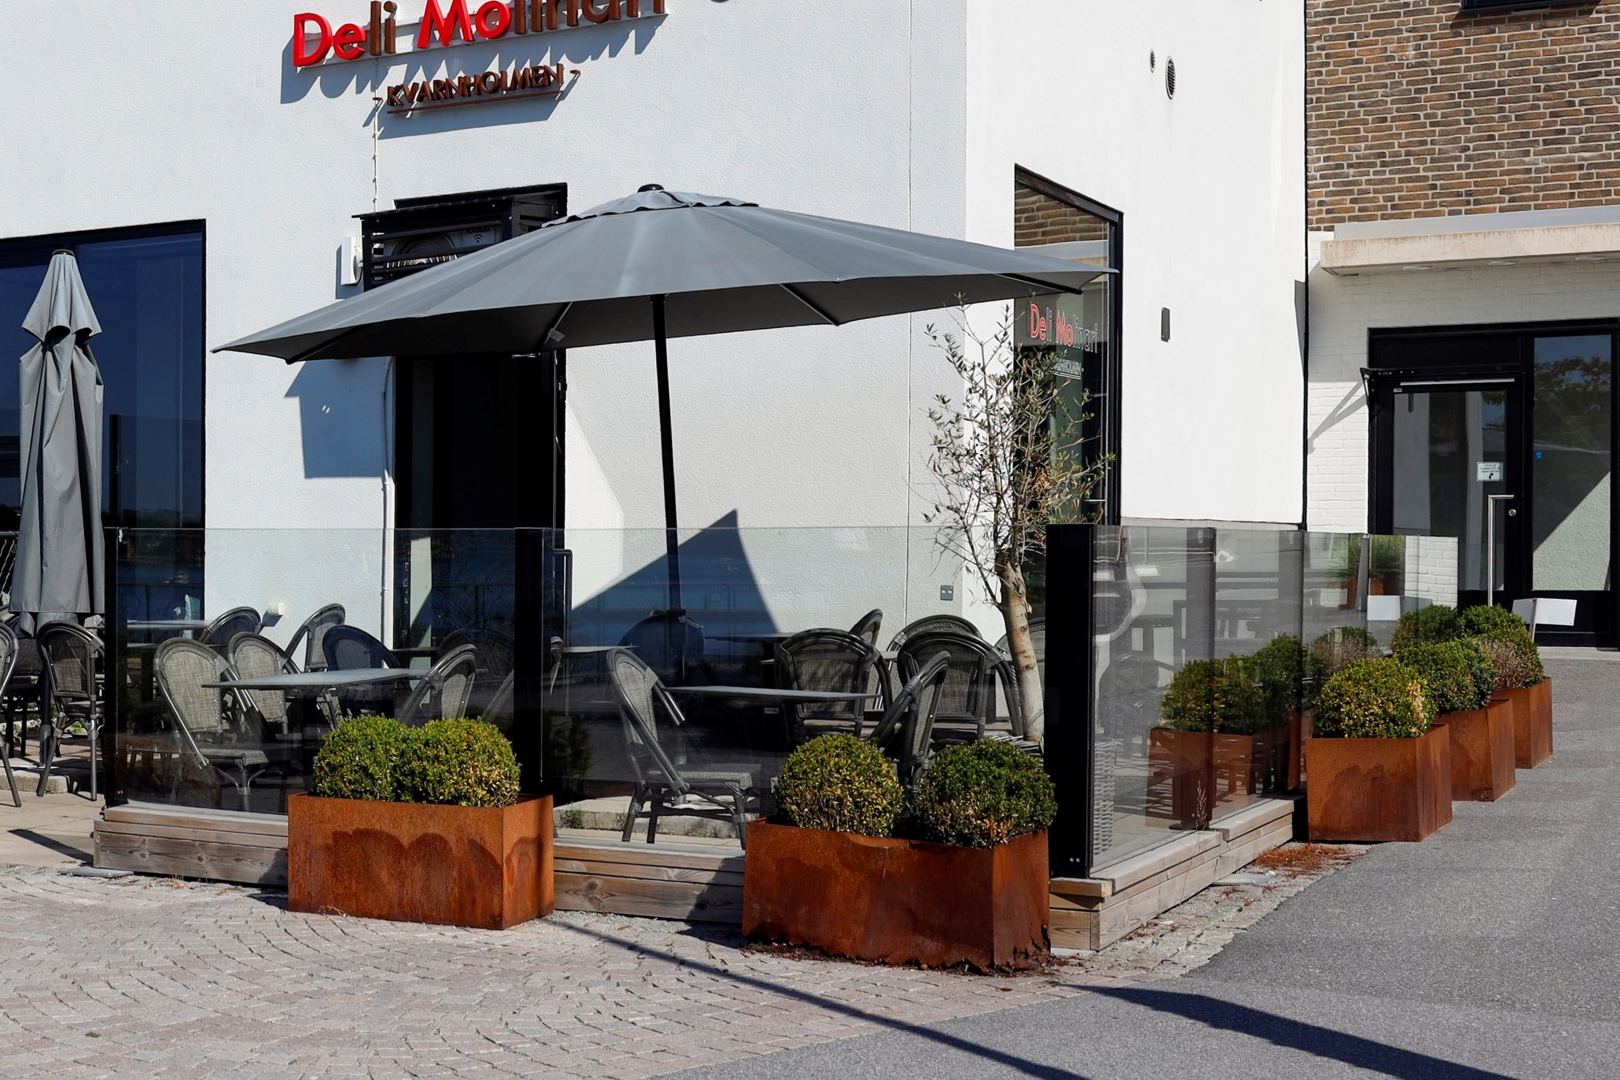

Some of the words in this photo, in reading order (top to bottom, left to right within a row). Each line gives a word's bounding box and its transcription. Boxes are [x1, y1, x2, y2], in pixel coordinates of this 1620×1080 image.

[293, 0, 397, 67] Deli
[387, 63, 564, 107] KVARNHOLMEN
[1031, 304, 1053, 342] Deli
[1056, 309, 1098, 354] Molinari
